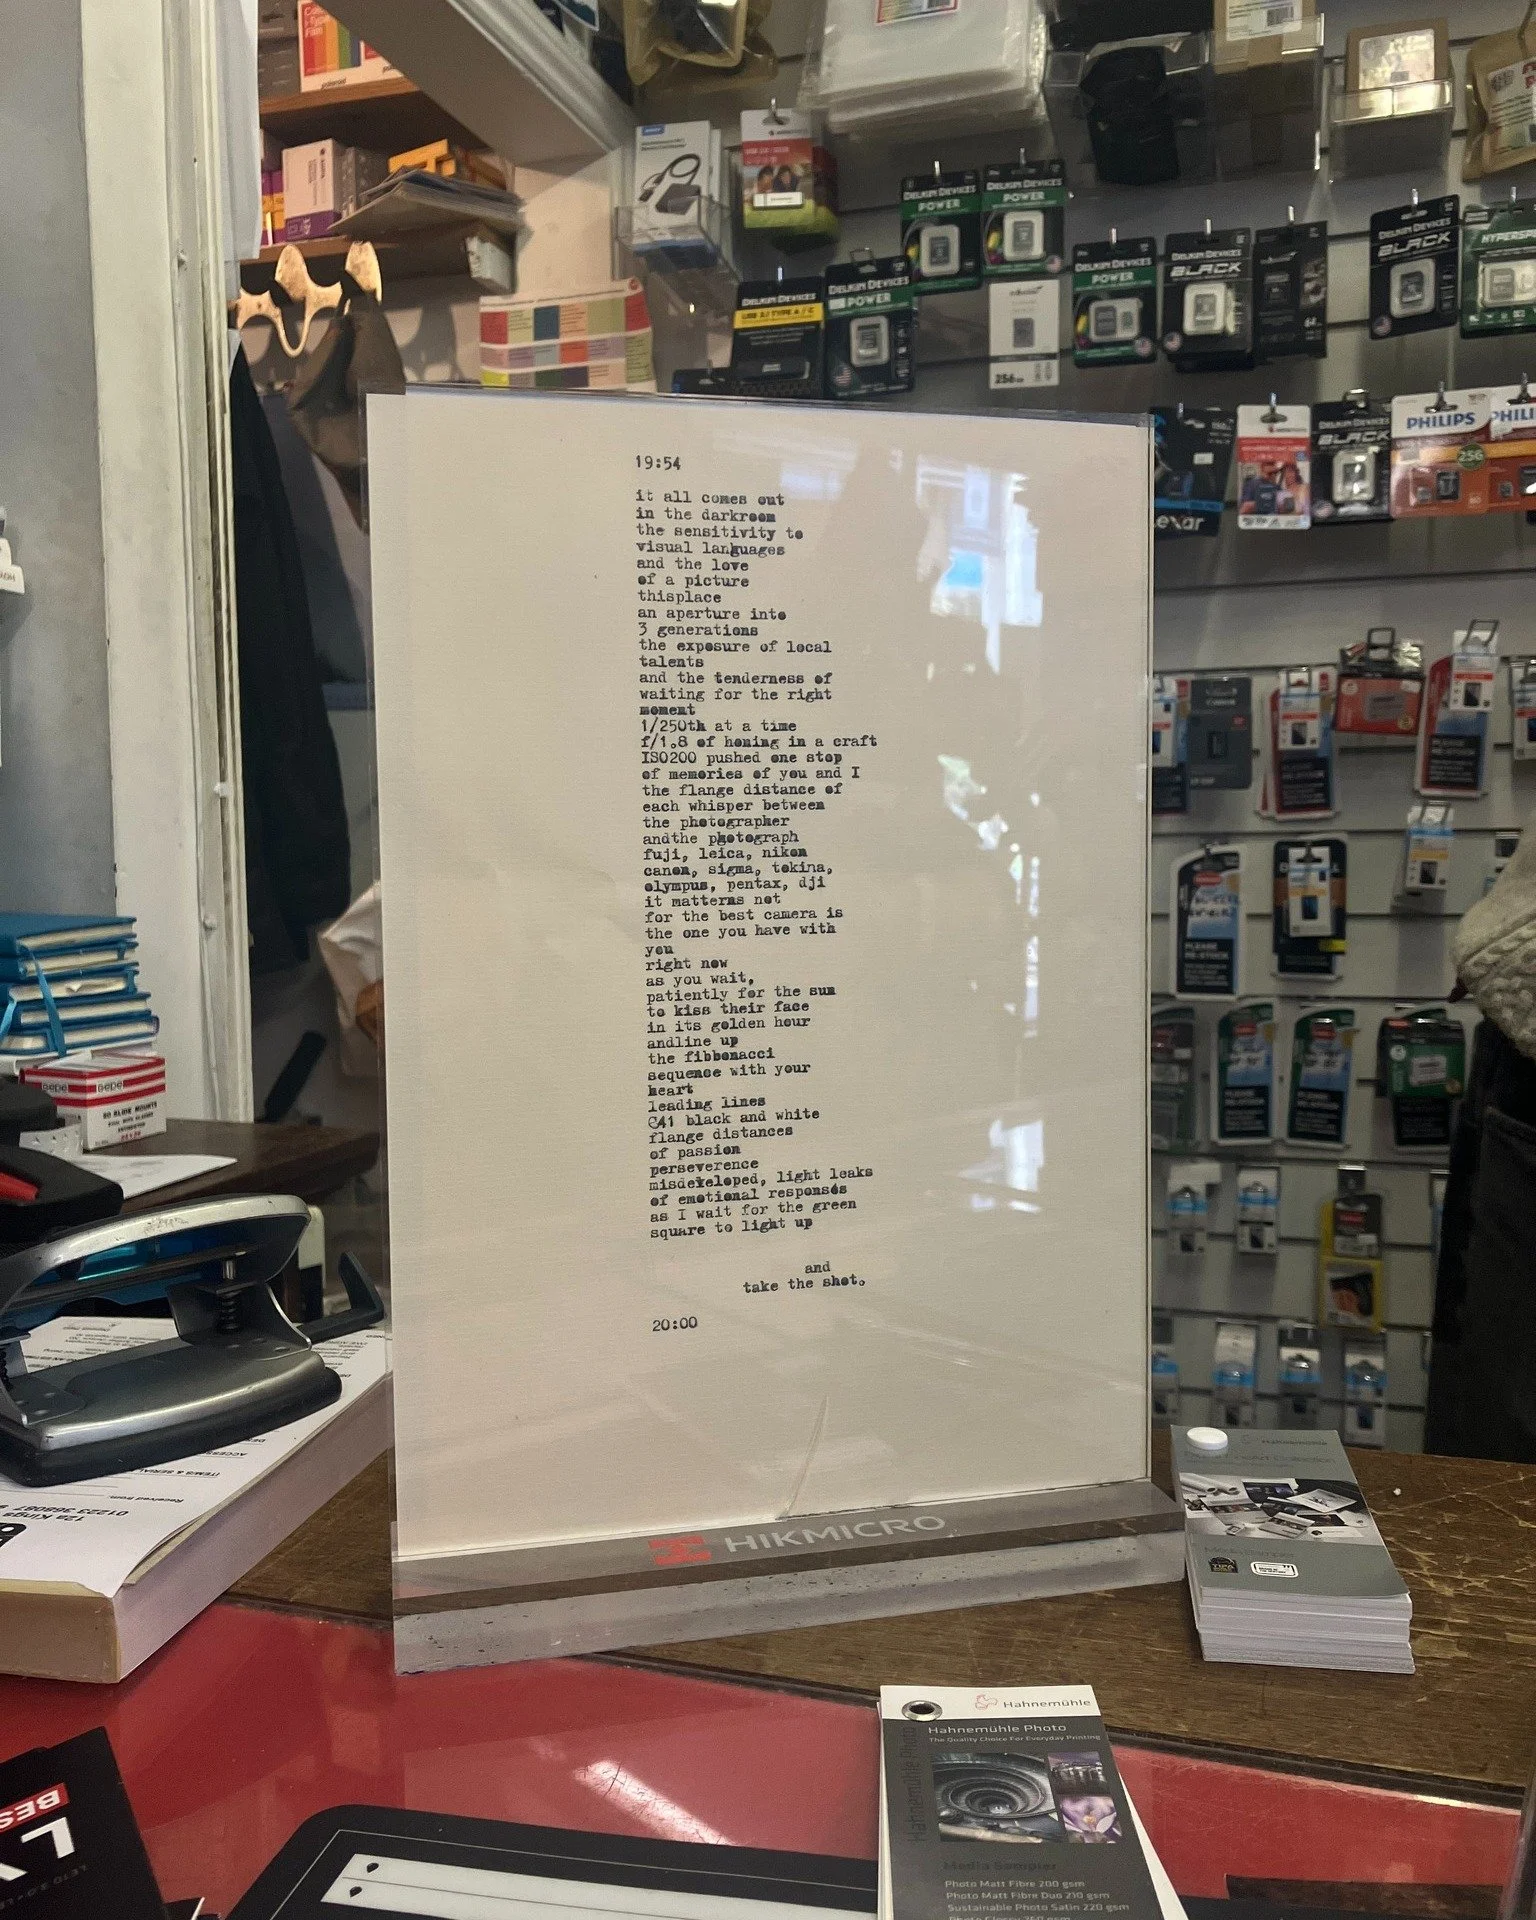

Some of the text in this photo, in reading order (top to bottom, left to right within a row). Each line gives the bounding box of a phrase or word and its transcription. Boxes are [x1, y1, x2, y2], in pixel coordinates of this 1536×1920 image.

[1003, 191, 1046, 202] POWER
[918, 199, 961, 212] POWER
[1378, 232, 1451, 258] BLACK
[1092, 271, 1134, 284] POWER
[1170, 262, 1242, 278] BLACK
[847, 292, 892, 306] POWER
[1407, 411, 1476, 429] PHILIPS
[1317, 430, 1391, 446] BLACK
[636, 454, 681, 471] 19:54
[636, 489, 785, 506] it all comes out
[636, 506, 776, 523] in the darkroom
[1155, 514, 1206, 531] exar
[637, 523, 803, 542] the sensitivity to
[636, 540, 785, 559] visual languages
[637, 557, 749, 572] and the love
[638, 606, 786, 622] an aperture into
[639, 622, 758, 638] 3 generations
[639, 654, 704, 668] talents
[639, 671, 833, 685] and the tenderness of
[639, 687, 832, 704] waiting for the right
[639, 702, 695, 717] moment
[707, 751, 761, 767] pushed
[771, 754, 797, 764] one
[807, 751, 842, 765] stop
[642, 782, 843, 799] the flange distance of
[643, 798, 825, 814] each whisper between
[643, 814, 790, 831] the photographer
[643, 845, 808, 864] fuji, leica, nikon
[644, 861, 832, 881] canon, sigma, tokina,
[644, 875, 826, 897] olympus, pentax, dji
[645, 945, 674, 958] you
[646, 957, 728, 973] right now
[647, 984, 837, 1006] patiently for the sun
[720, 1036, 738, 1049] up
[648, 1047, 775, 1065] the fibbonacci
[648, 1082, 693, 1097] heart
[648, 1095, 766, 1113] leading lines
[649, 1126, 793, 1147] flange distances
[650, 1144, 741, 1161] of passion
[650, 1159, 759, 1179] perseverence
[651, 1216, 813, 1241] square to light up
[805, 1260, 830, 1274] and
[743, 1274, 865, 1294] take the shot.
[653, 1316, 698, 1332] 20:00
[77, 1508, 129, 1516] 01223
[724, 1515, 946, 1553] HIKMICRO
[1003, 1698, 1091, 1709] Hahnemühle
[928, 1723, 1067, 1734] Hahnemühle Photo
[946, 1736, 978, 1744] Quality
[979, 1735, 1008, 1743] Choice
[1026, 1735, 1065, 1743] Everyday
[1066, 1734, 1101, 1742] Printing
[945, 1880, 1086, 1889] Photo Matt Fibre 200 gsm
[946, 1892, 979, 1900] Photo
[1011, 1892, 1038, 1900] Fibre
[1086, 1893, 1110, 1901] gsm
[947, 1903, 1130, 1913] Sustainable Photo Satin 220 gsm
